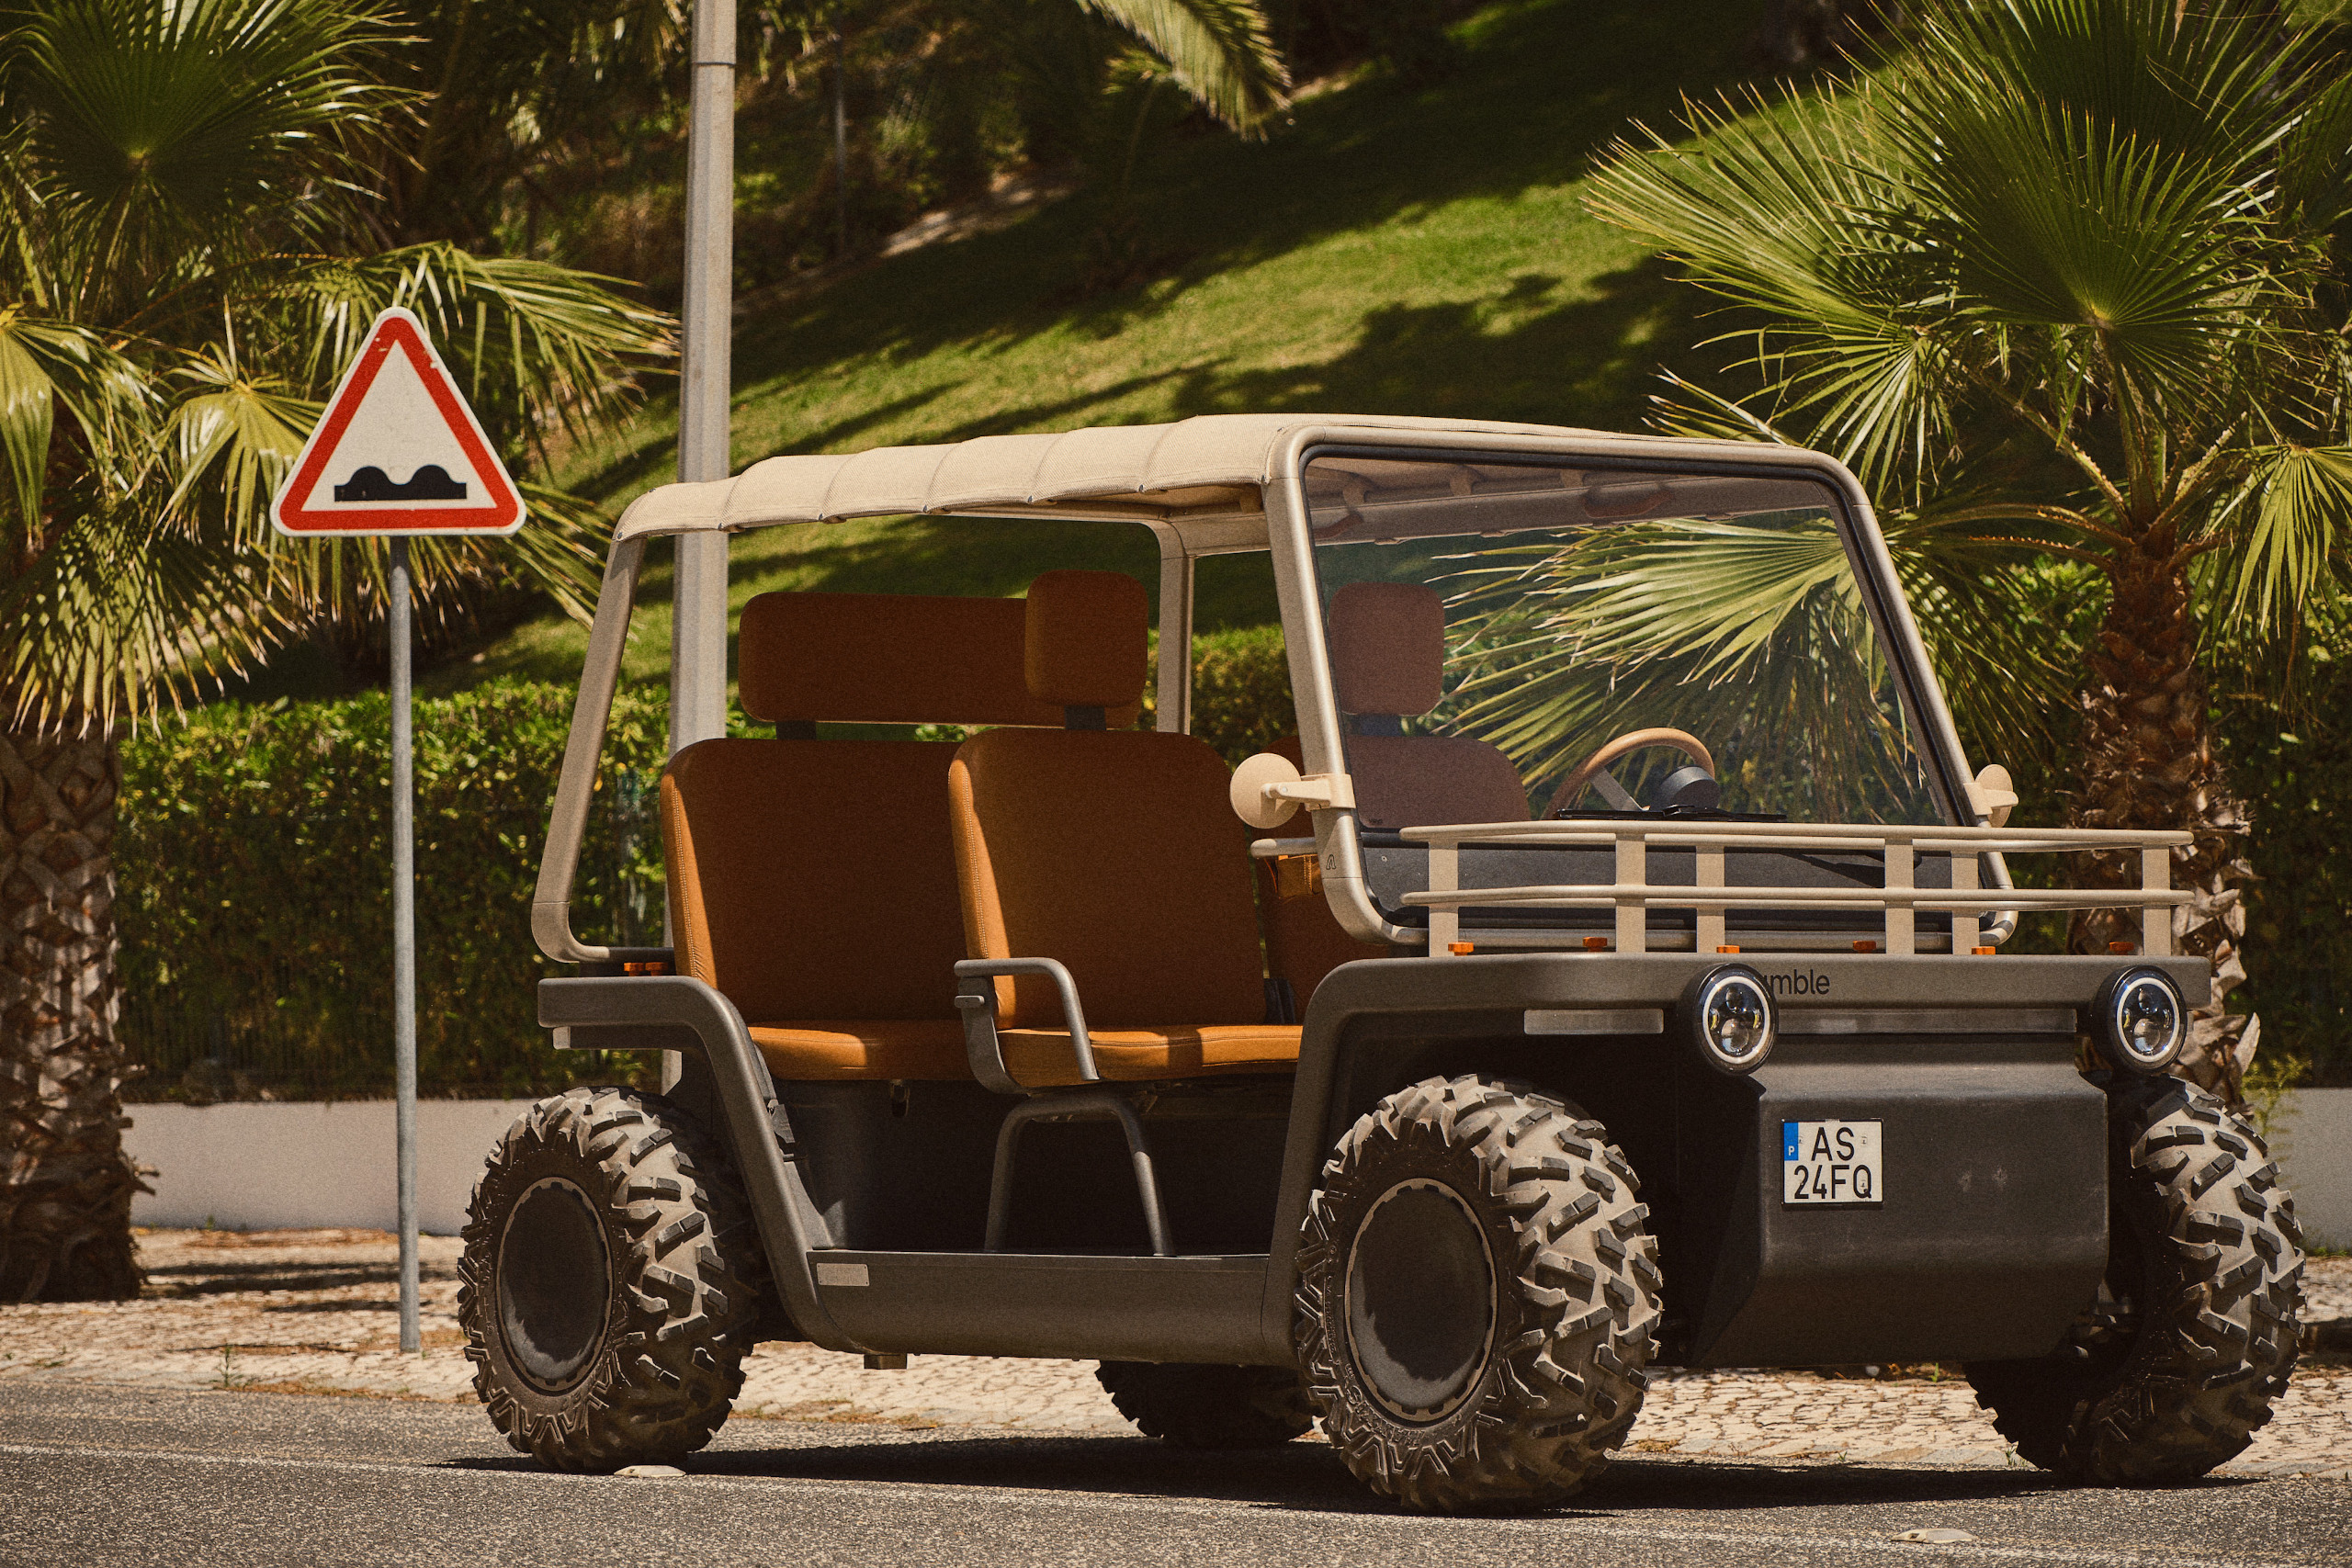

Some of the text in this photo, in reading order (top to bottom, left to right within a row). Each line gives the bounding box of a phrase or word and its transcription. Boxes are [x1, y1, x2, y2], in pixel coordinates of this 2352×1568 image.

[1788, 1145, 1795, 1156] P
[1811, 1126, 1855, 1161] AS
[1793, 1164, 1872, 1200] 24FQ
